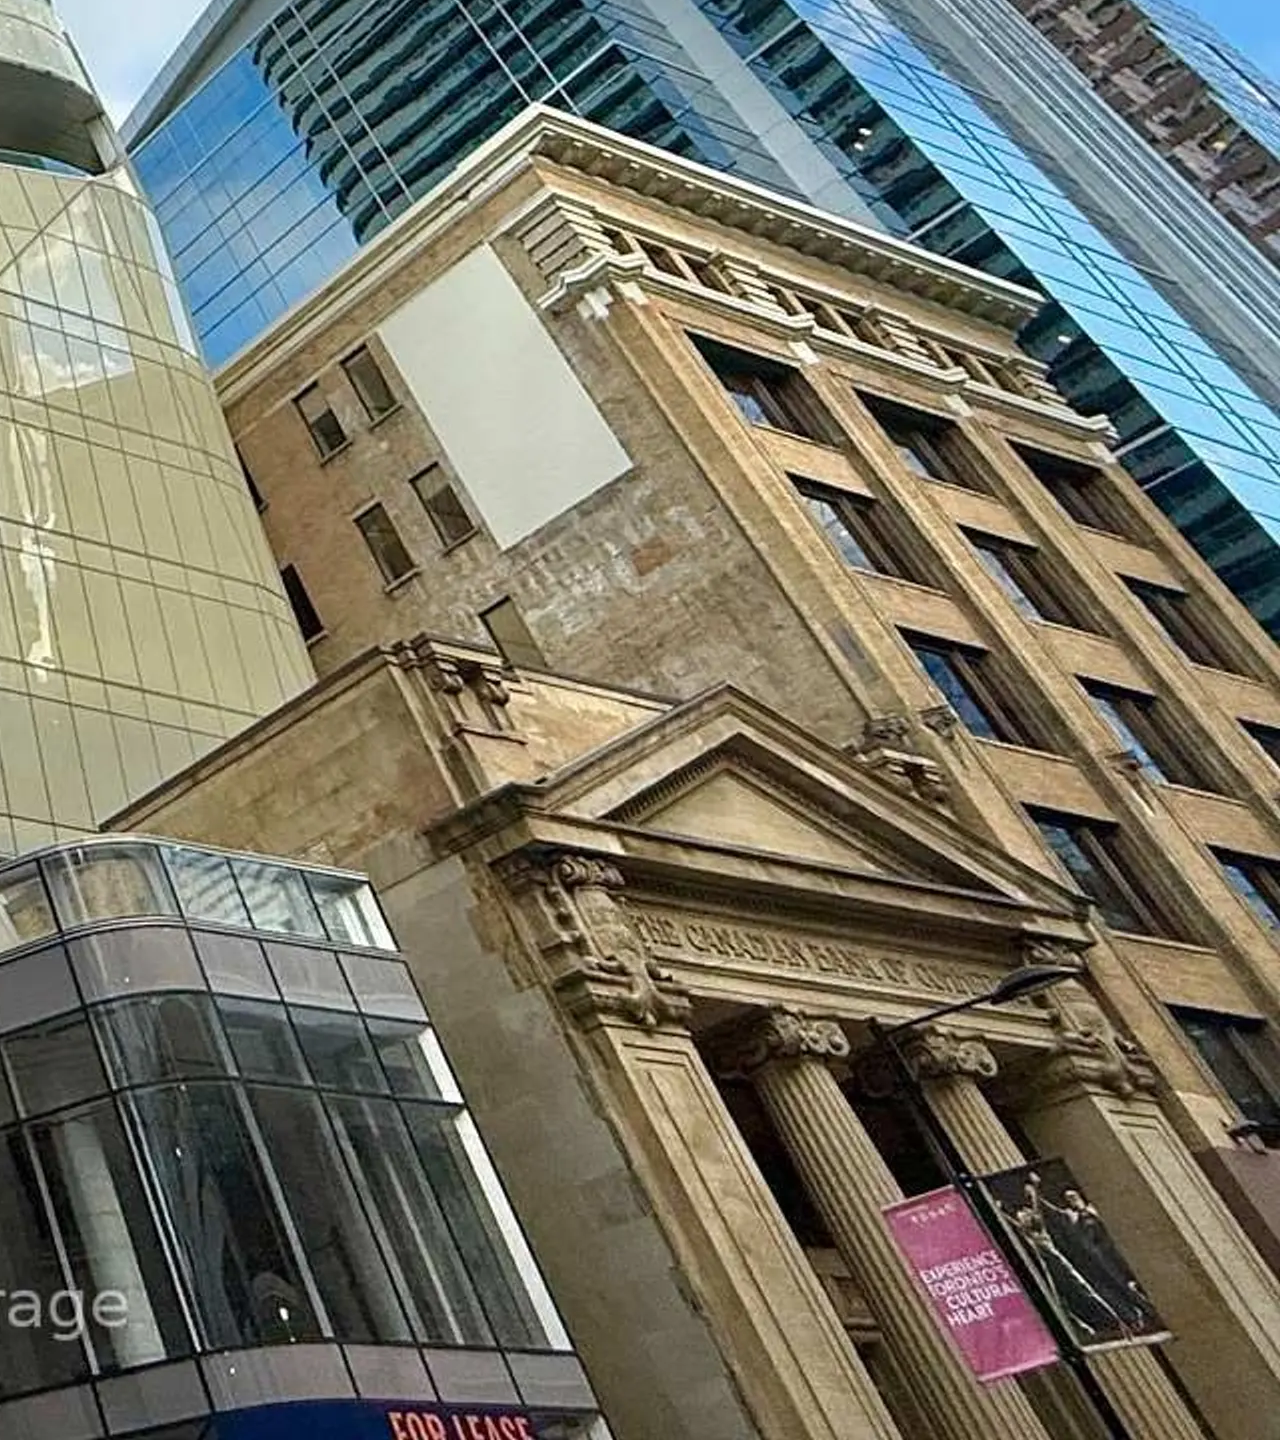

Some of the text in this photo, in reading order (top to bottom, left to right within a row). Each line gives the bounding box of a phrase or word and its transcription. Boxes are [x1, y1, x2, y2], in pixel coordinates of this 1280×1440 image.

[920, 1250, 1003, 1284] EXPERIENCE
[928, 1265, 1011, 1298] TORONTO'S
[945, 1280, 1021, 1310] CULTURAL
[945, 1303, 994, 1328] HEART
[388, 1412, 447, 1440] FOR
